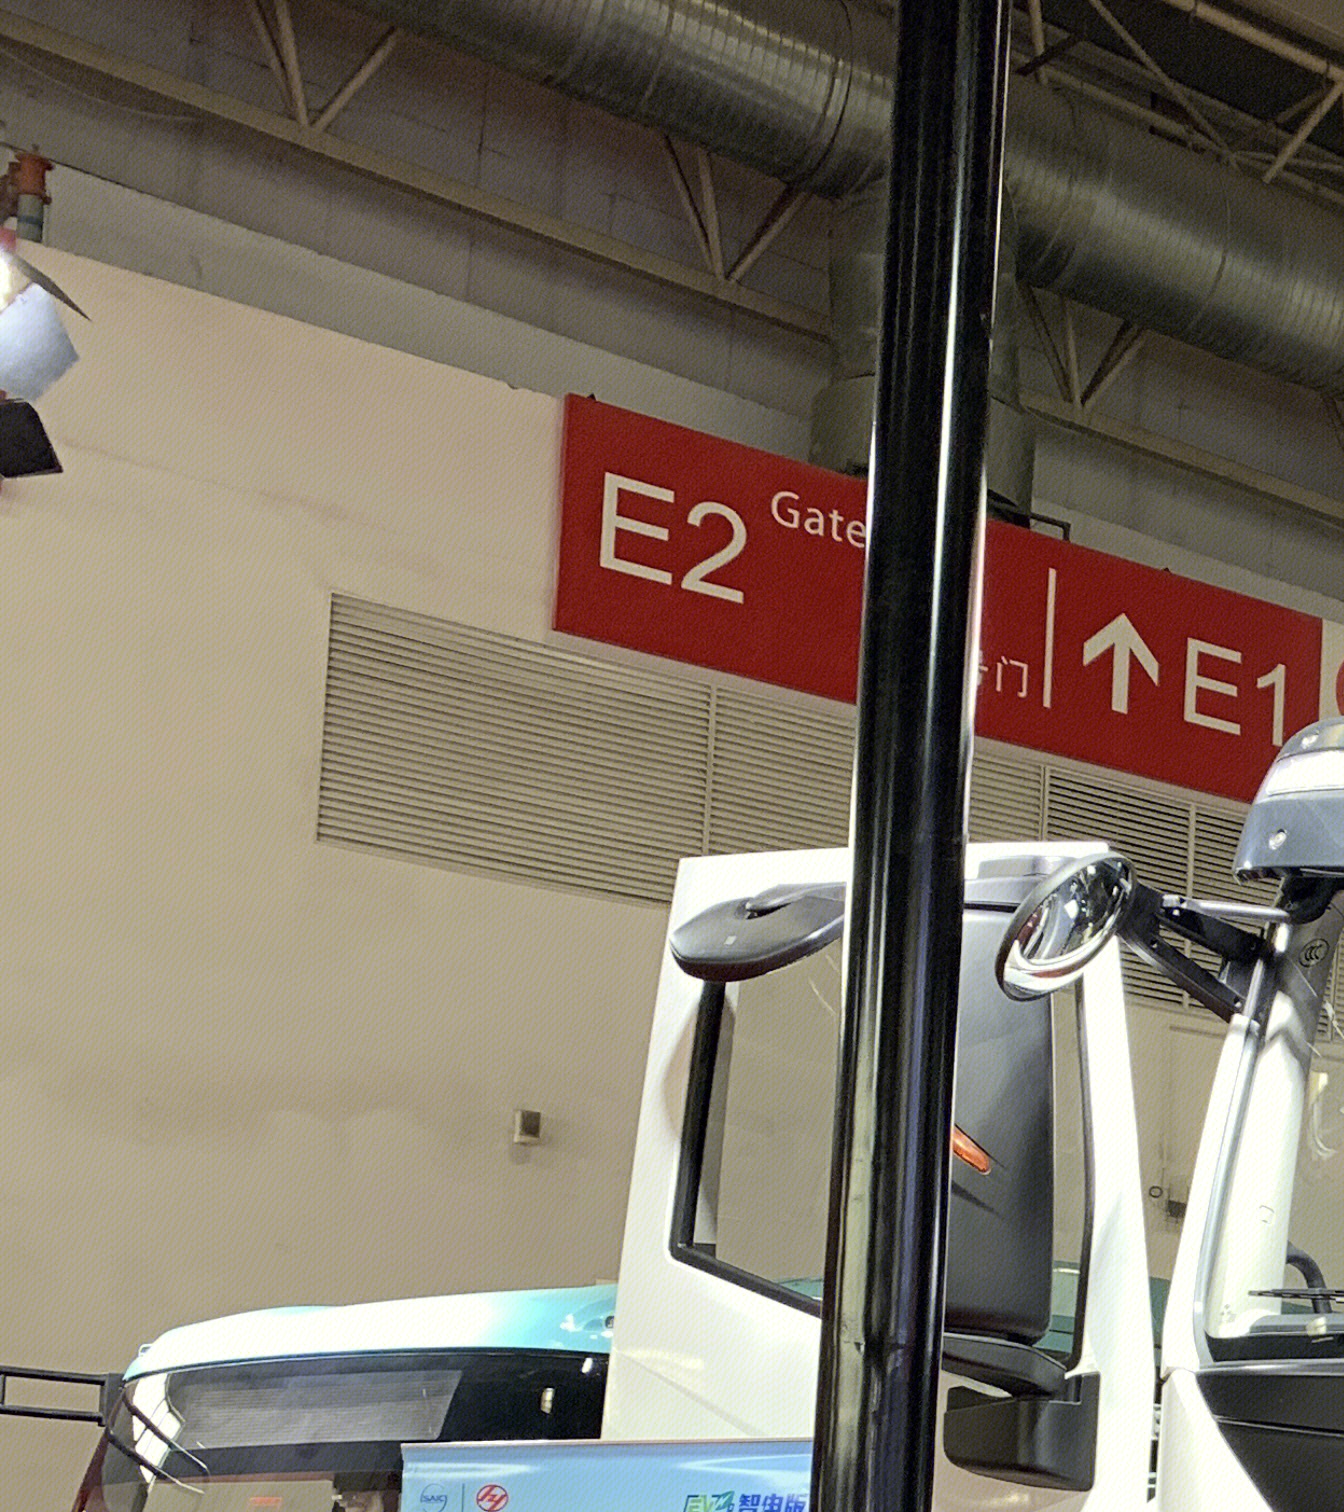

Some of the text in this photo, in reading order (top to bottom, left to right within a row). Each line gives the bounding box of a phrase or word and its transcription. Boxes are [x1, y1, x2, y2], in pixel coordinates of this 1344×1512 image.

[600, 472, 748, 604] E2
[771, 490, 867, 548] Gate
[1184, 636, 1288, 748] E1
